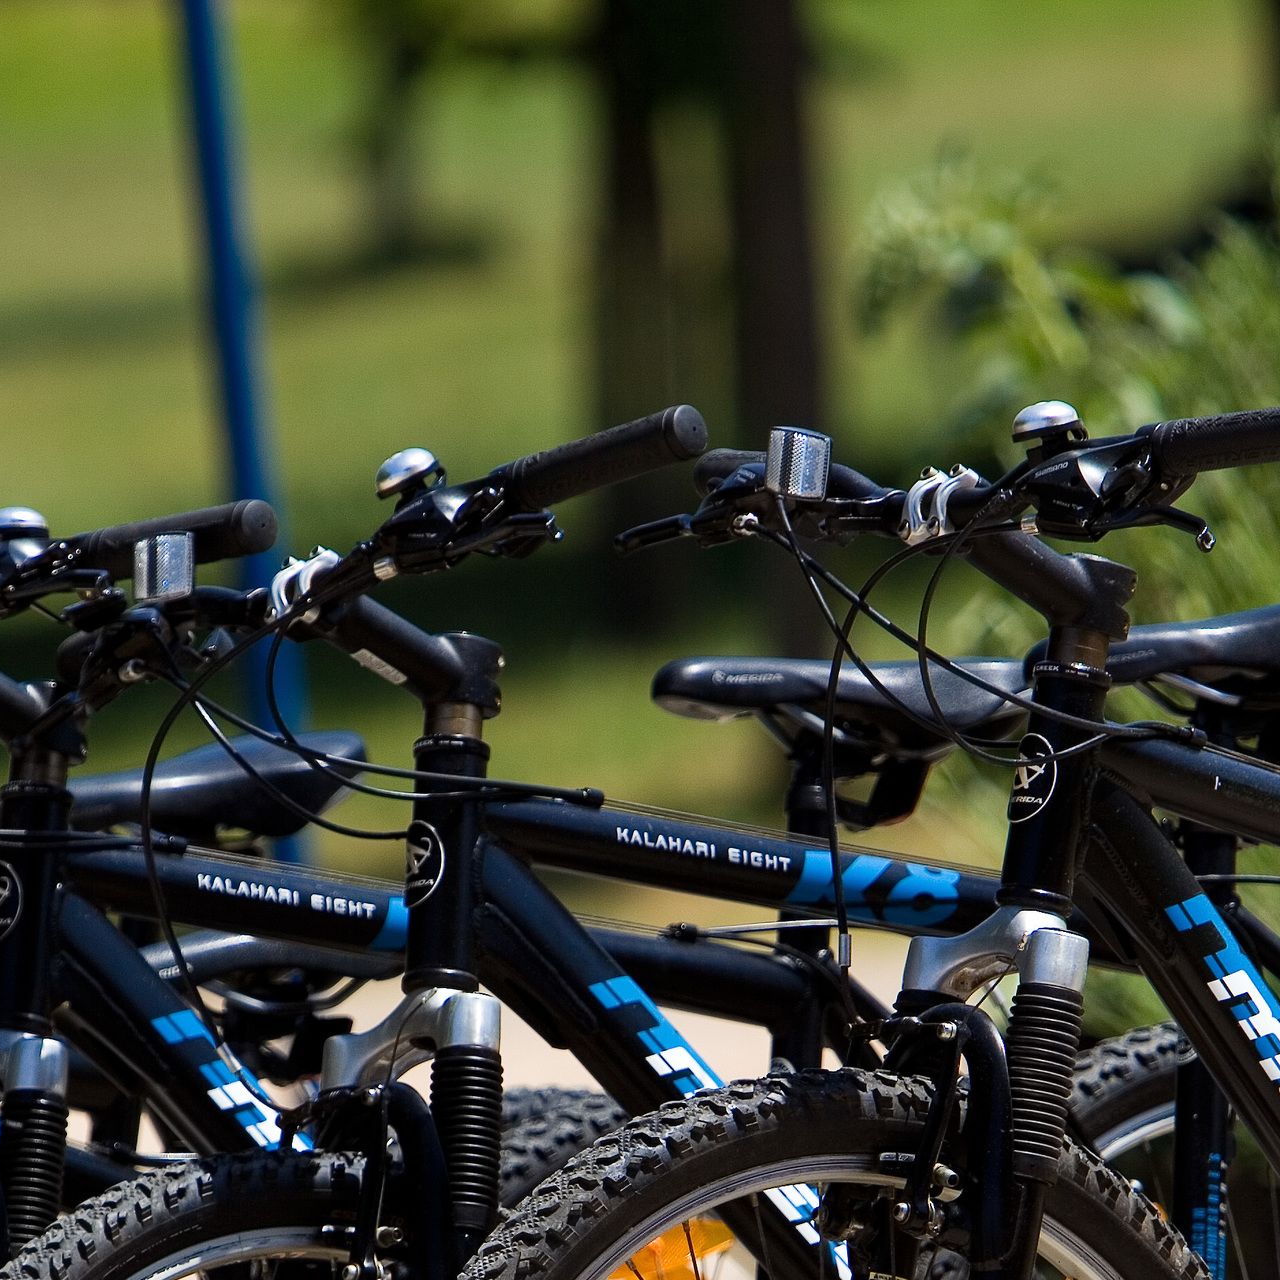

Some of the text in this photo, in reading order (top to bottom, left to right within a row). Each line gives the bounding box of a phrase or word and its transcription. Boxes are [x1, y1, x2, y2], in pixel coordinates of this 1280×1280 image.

[725, 673, 784, 685] MERIDA
[616, 827, 791, 872] KALAHARI EIGHT
[197, 873, 377, 919] KALAHARI EIGHT
